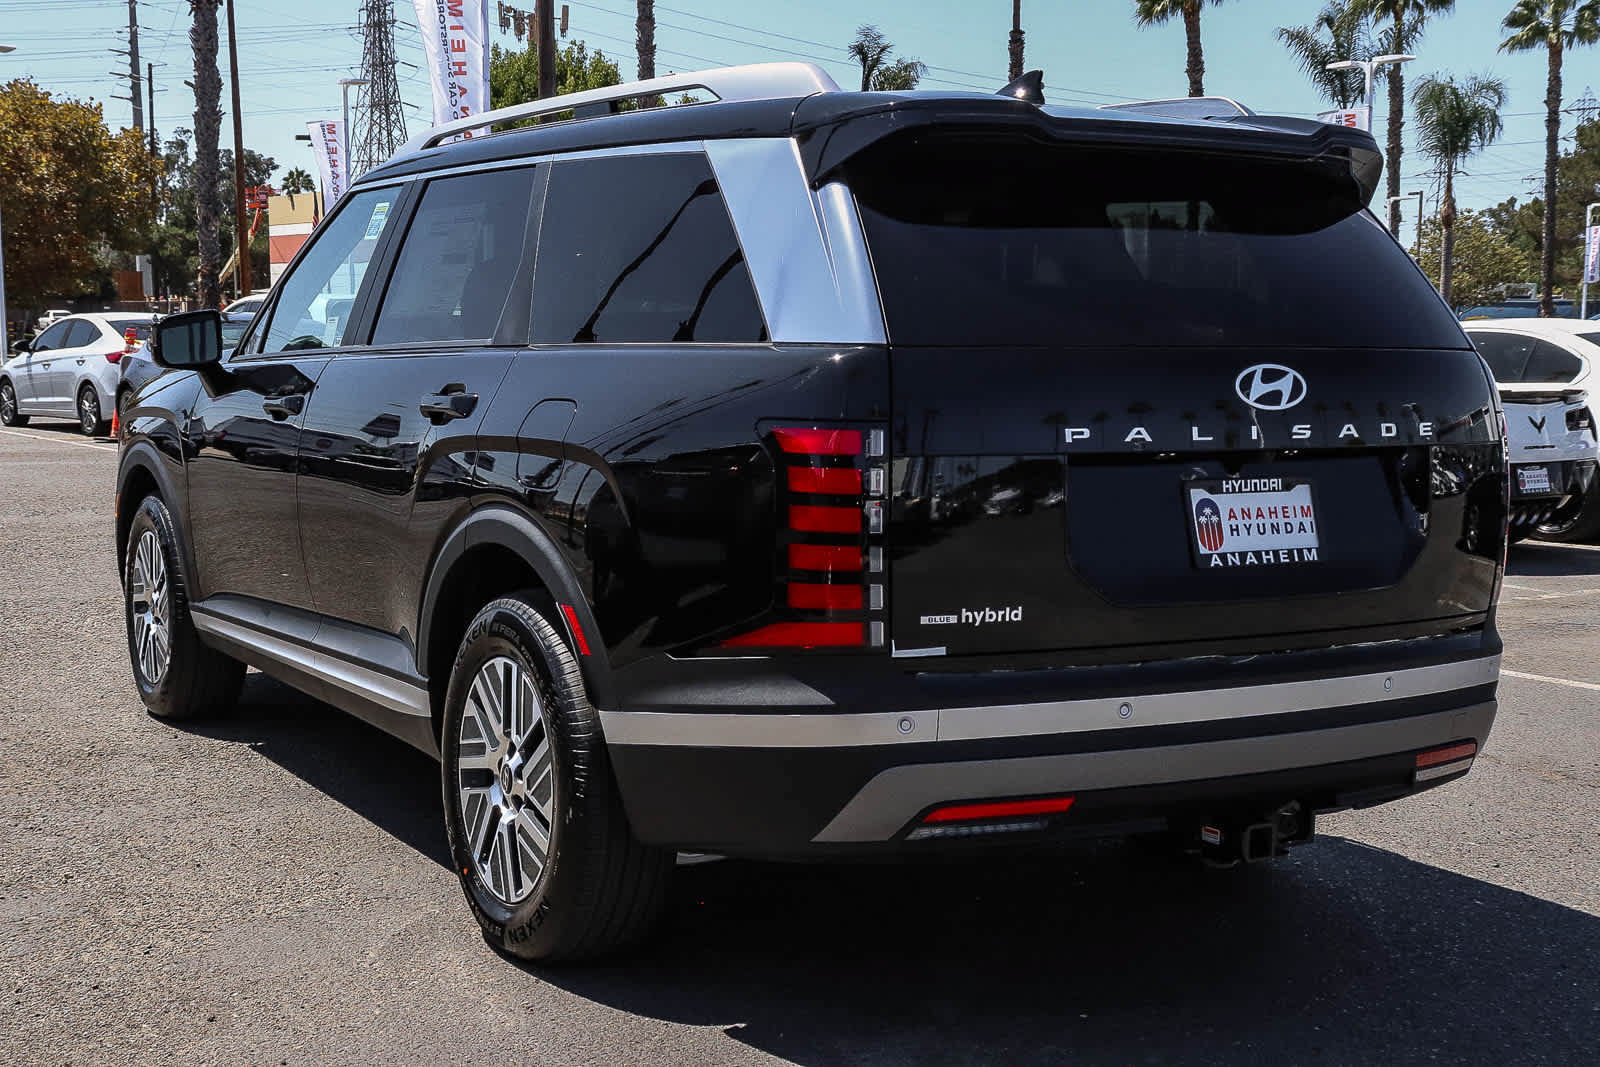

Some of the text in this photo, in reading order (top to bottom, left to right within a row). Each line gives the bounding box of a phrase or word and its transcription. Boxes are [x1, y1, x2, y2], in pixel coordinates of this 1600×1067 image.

[1064, 422, 1434, 443] PALISADE
[1222, 478, 1282, 493] HYUNDAI
[1228, 504, 1312, 520] ANAHEIM
[1229, 521, 1315, 537] HYUNDAI
[1210, 548, 1318, 567] ANAHEIM
[927, 606, 1022, 626] BLUE hybrid
